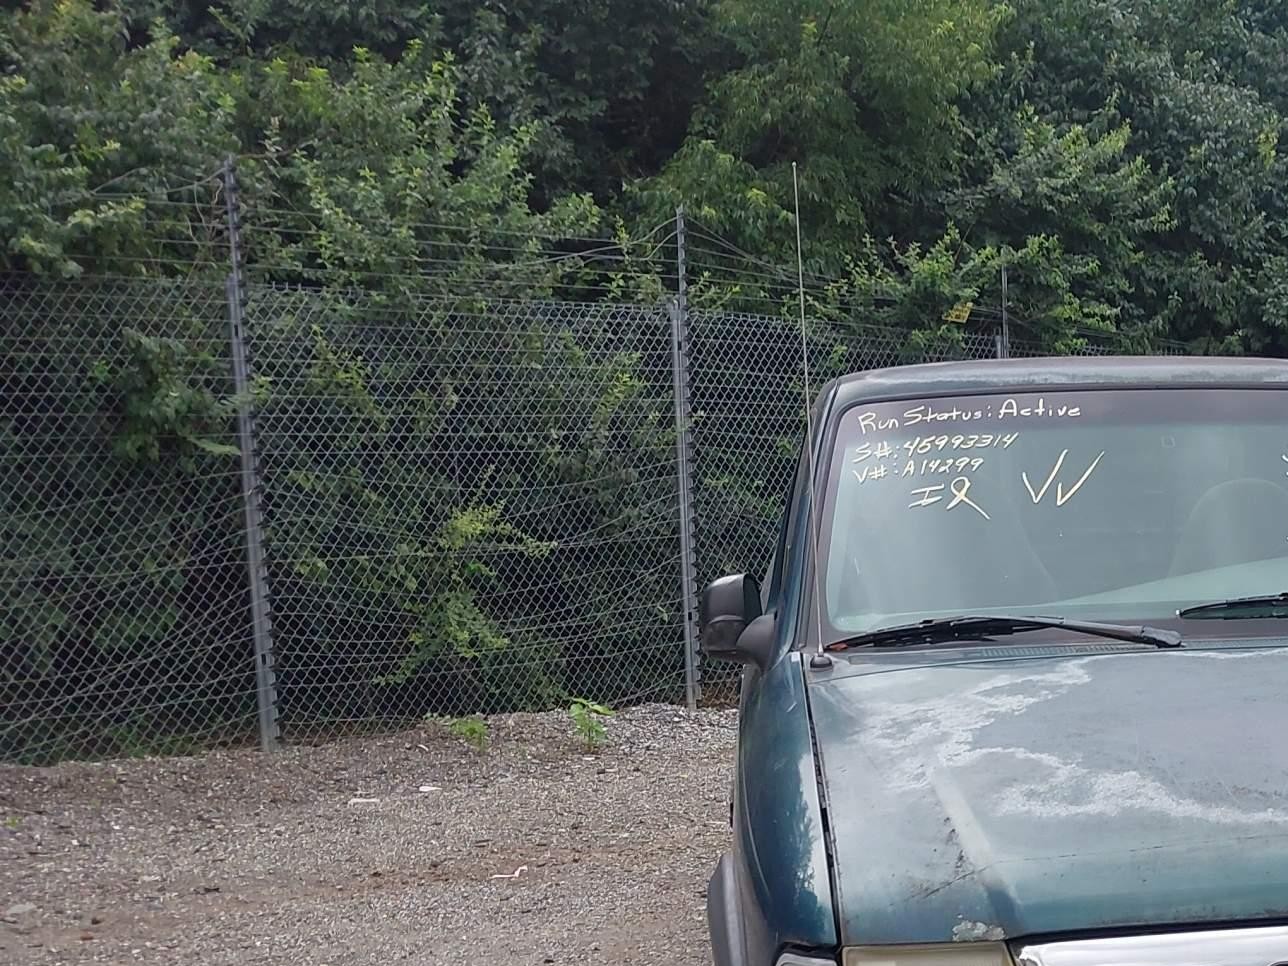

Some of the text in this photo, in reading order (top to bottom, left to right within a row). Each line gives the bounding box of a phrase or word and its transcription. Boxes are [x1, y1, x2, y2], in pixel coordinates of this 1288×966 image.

[858, 398, 1081, 435] Run Status: Active
[903, 431, 1019, 457] 45993314
